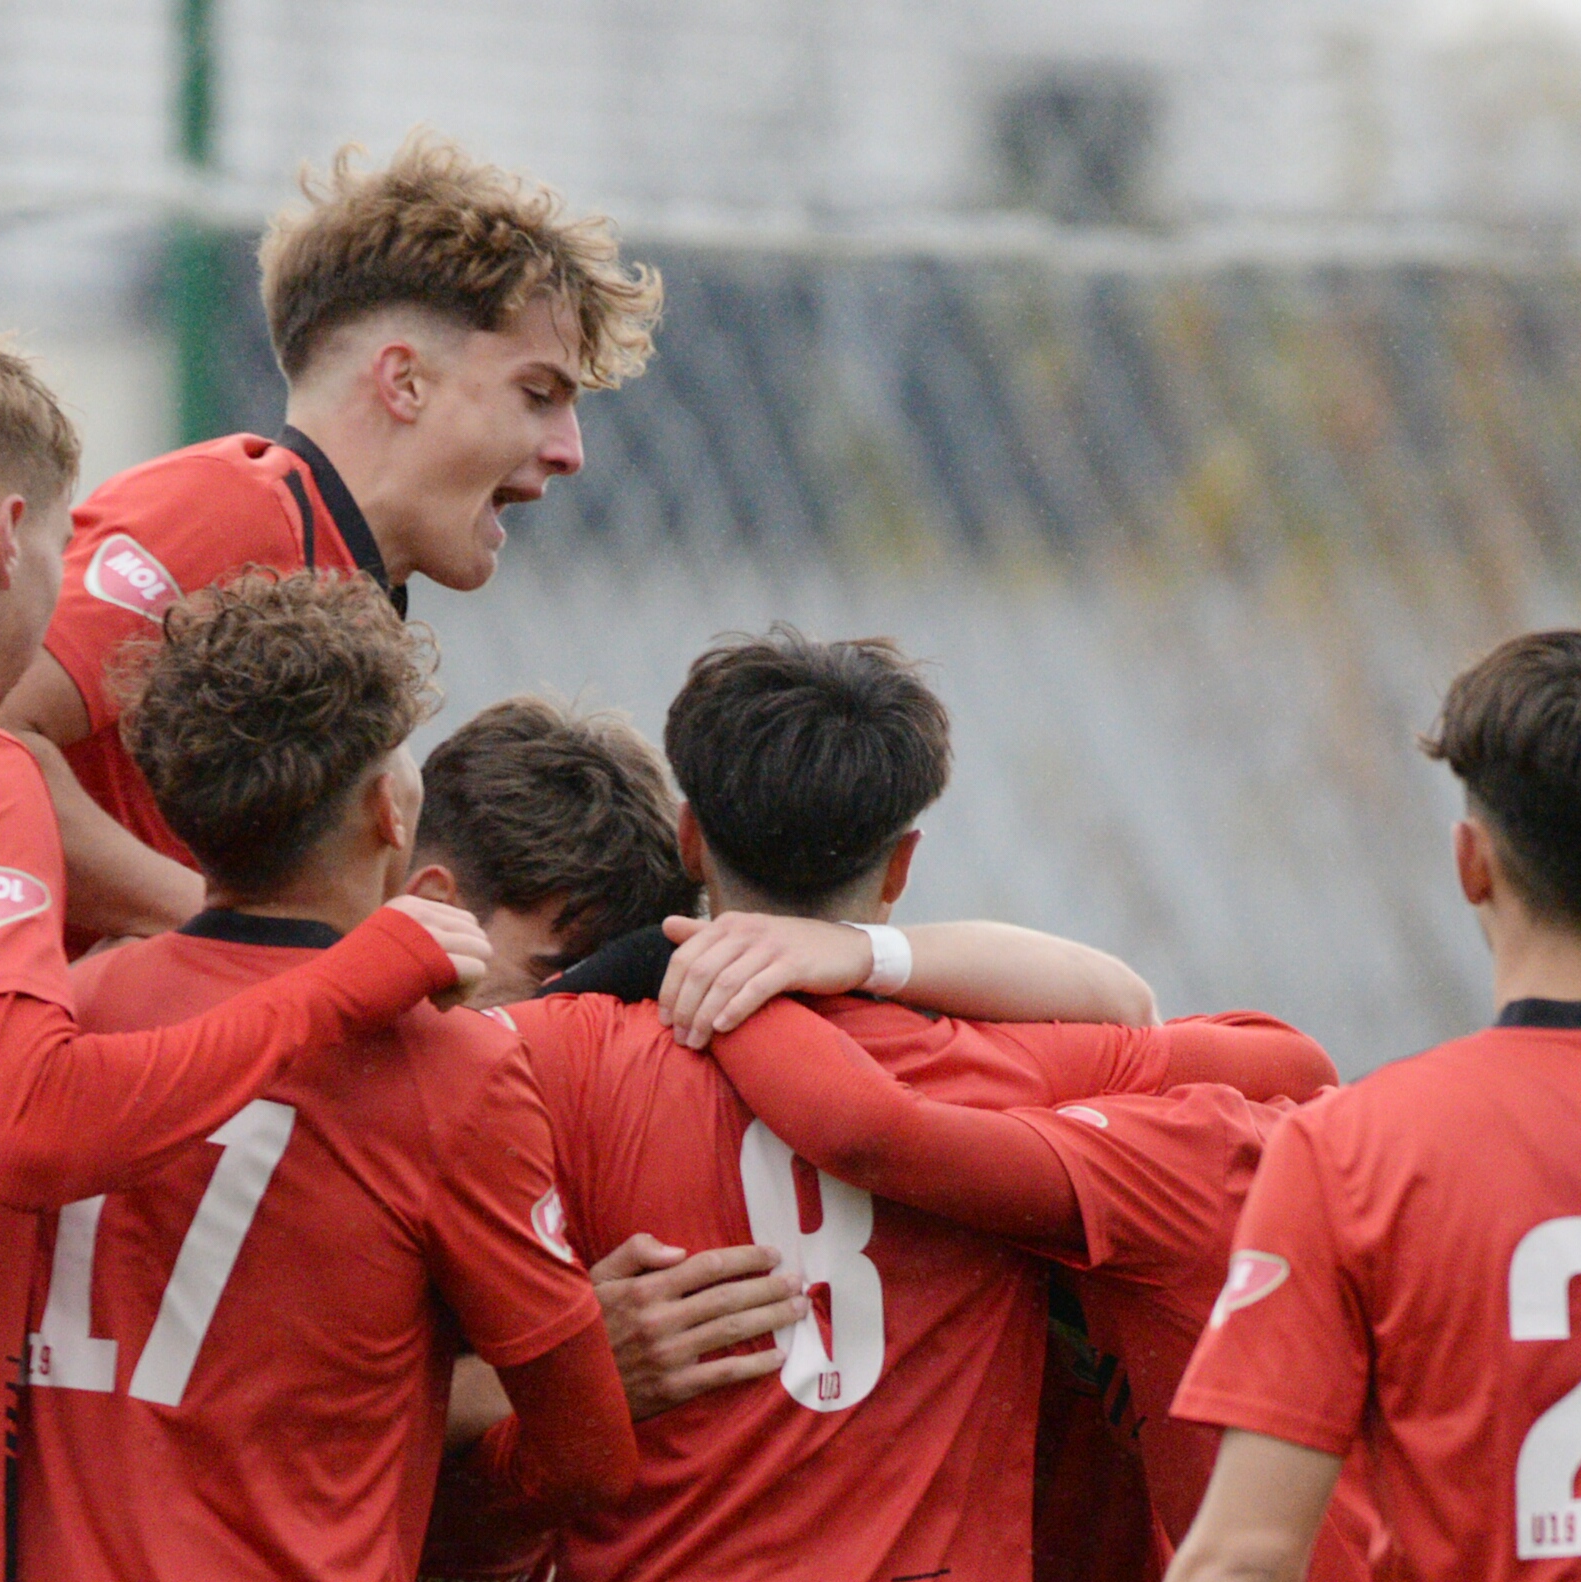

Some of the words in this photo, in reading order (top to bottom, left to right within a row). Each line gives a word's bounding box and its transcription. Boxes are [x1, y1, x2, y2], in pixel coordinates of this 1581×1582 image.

[104, 550, 167, 600] MOL
[26, 1098, 297, 1407] 17
[739, 1117, 886, 1413] 8
